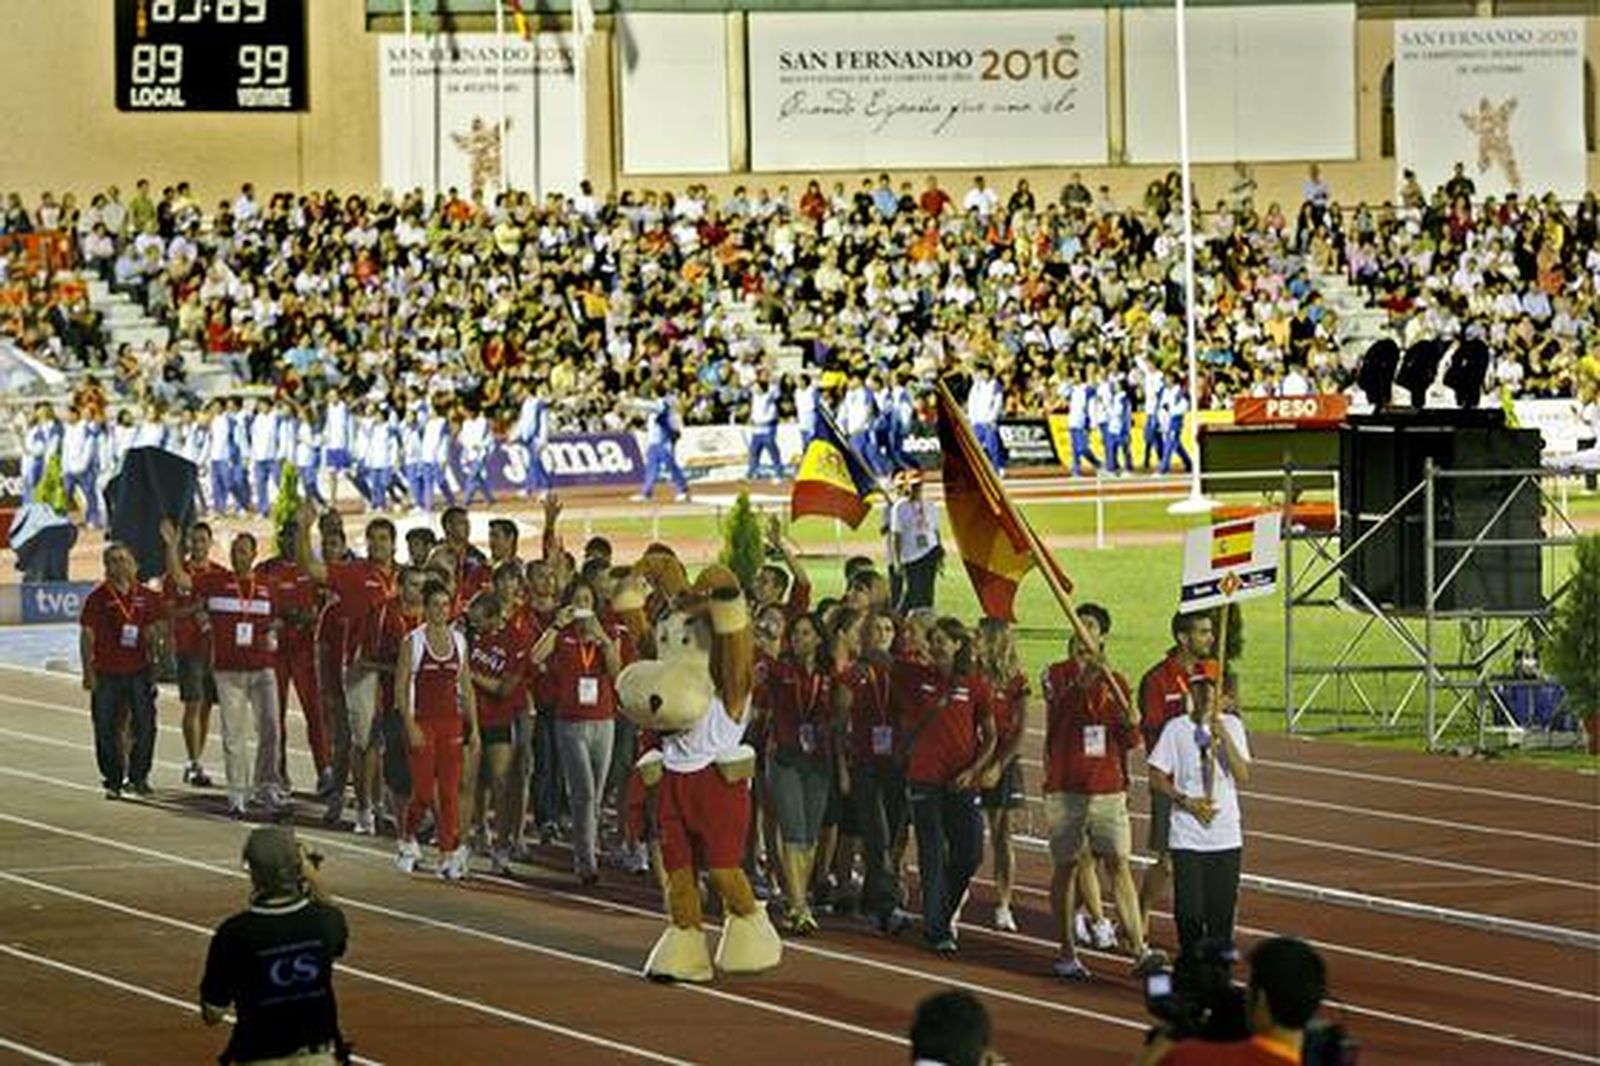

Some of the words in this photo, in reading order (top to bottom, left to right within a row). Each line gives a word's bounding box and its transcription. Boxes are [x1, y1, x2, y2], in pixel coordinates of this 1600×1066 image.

[132, 44, 184, 84] 89
[238, 44, 289, 84] 99
[779, 50, 828, 71] SAN
[834, 49, 974, 71] FERNANDO
[130, 86, 186, 107] LOCAL
[1265, 398, 1319, 419] PESO
[35, 588, 79, 618] tve
[269, 952, 319, 986] CS
